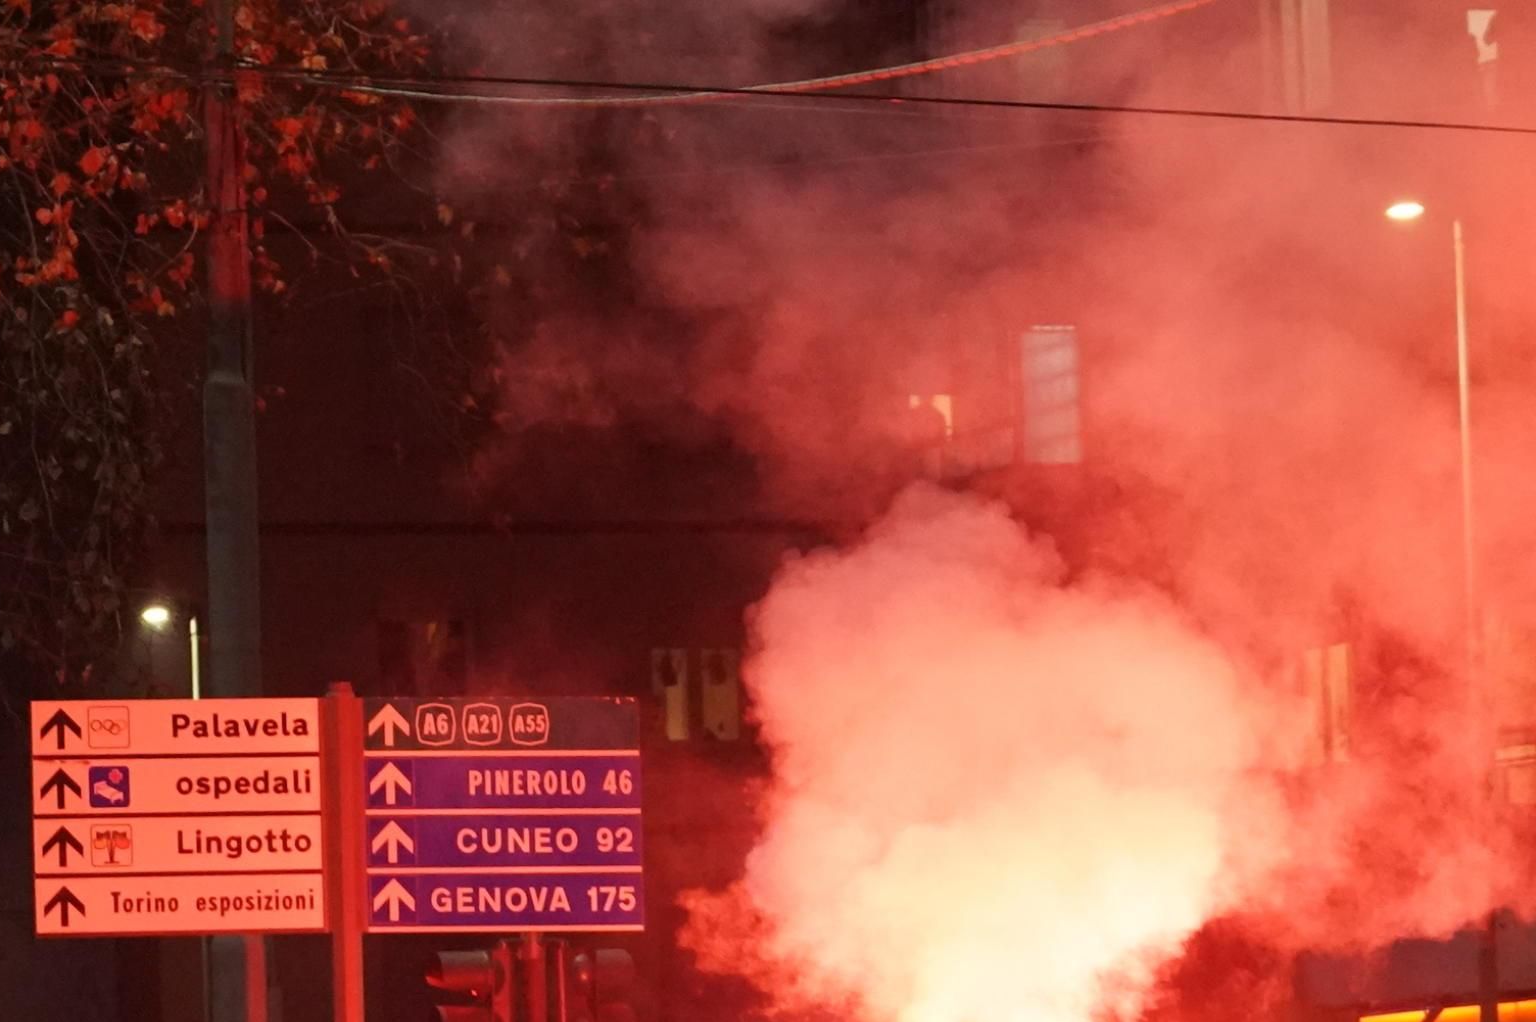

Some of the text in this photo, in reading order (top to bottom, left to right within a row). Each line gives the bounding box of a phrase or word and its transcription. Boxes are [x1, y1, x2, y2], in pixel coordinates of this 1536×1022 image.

[171, 712, 309, 738] Palavela
[423, 713, 546, 735] A6 A21 A55
[176, 769, 311, 799] ospedali
[468, 770, 634, 797] PINEROLO 46
[177, 829, 312, 859] Lingotto
[456, 827, 635, 855] CUNEO 92
[111, 890, 316, 917] Torino esposizioni
[430, 886, 637, 914] GENOVA 175
